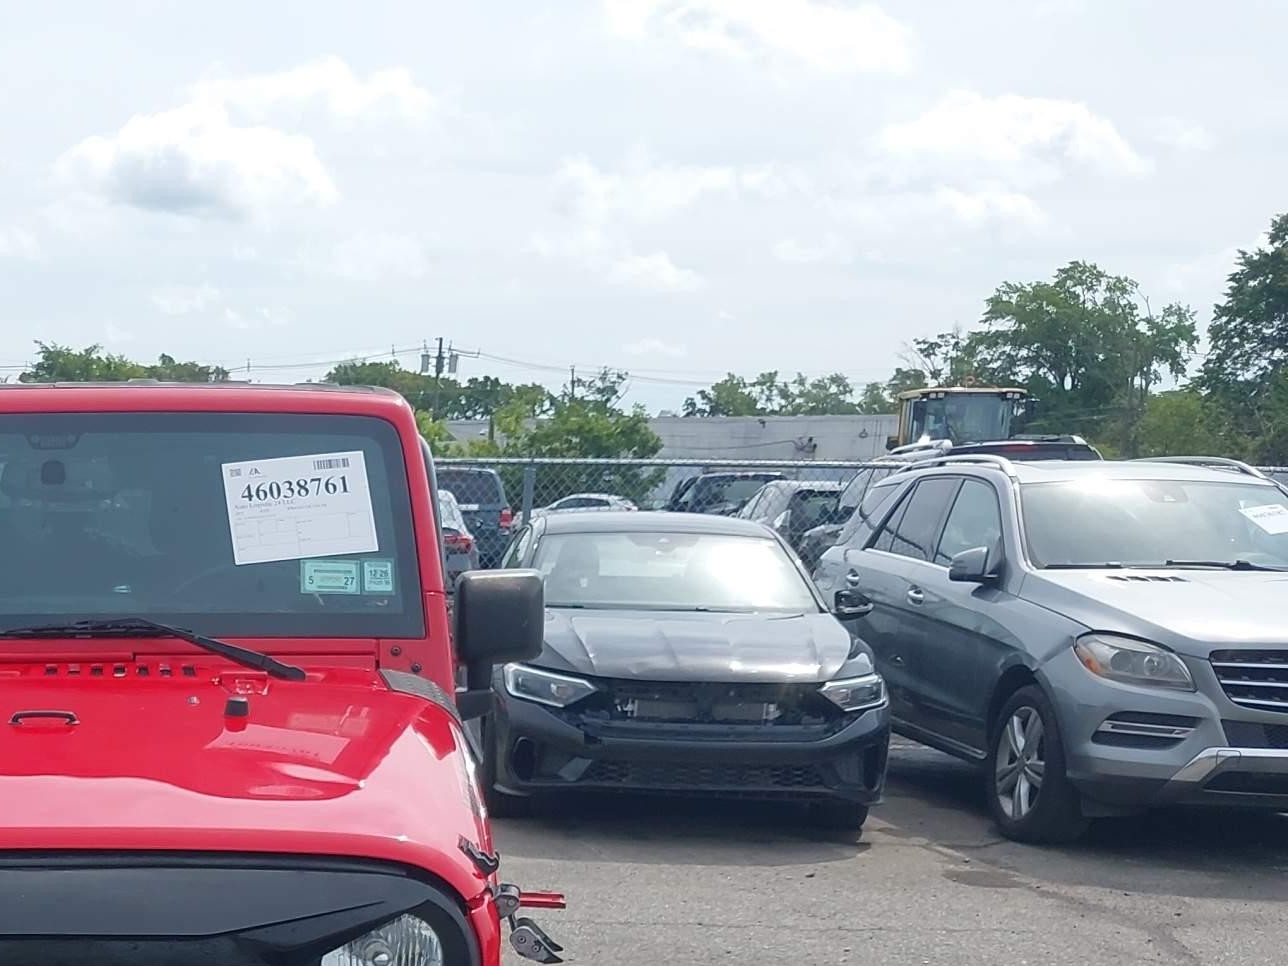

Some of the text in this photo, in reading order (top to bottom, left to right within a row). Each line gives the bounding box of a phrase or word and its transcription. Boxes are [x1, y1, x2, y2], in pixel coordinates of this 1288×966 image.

[241, 475, 350, 502] 46038761
[308, 575, 314, 585] 5
[343, 576, 355, 586] 27
